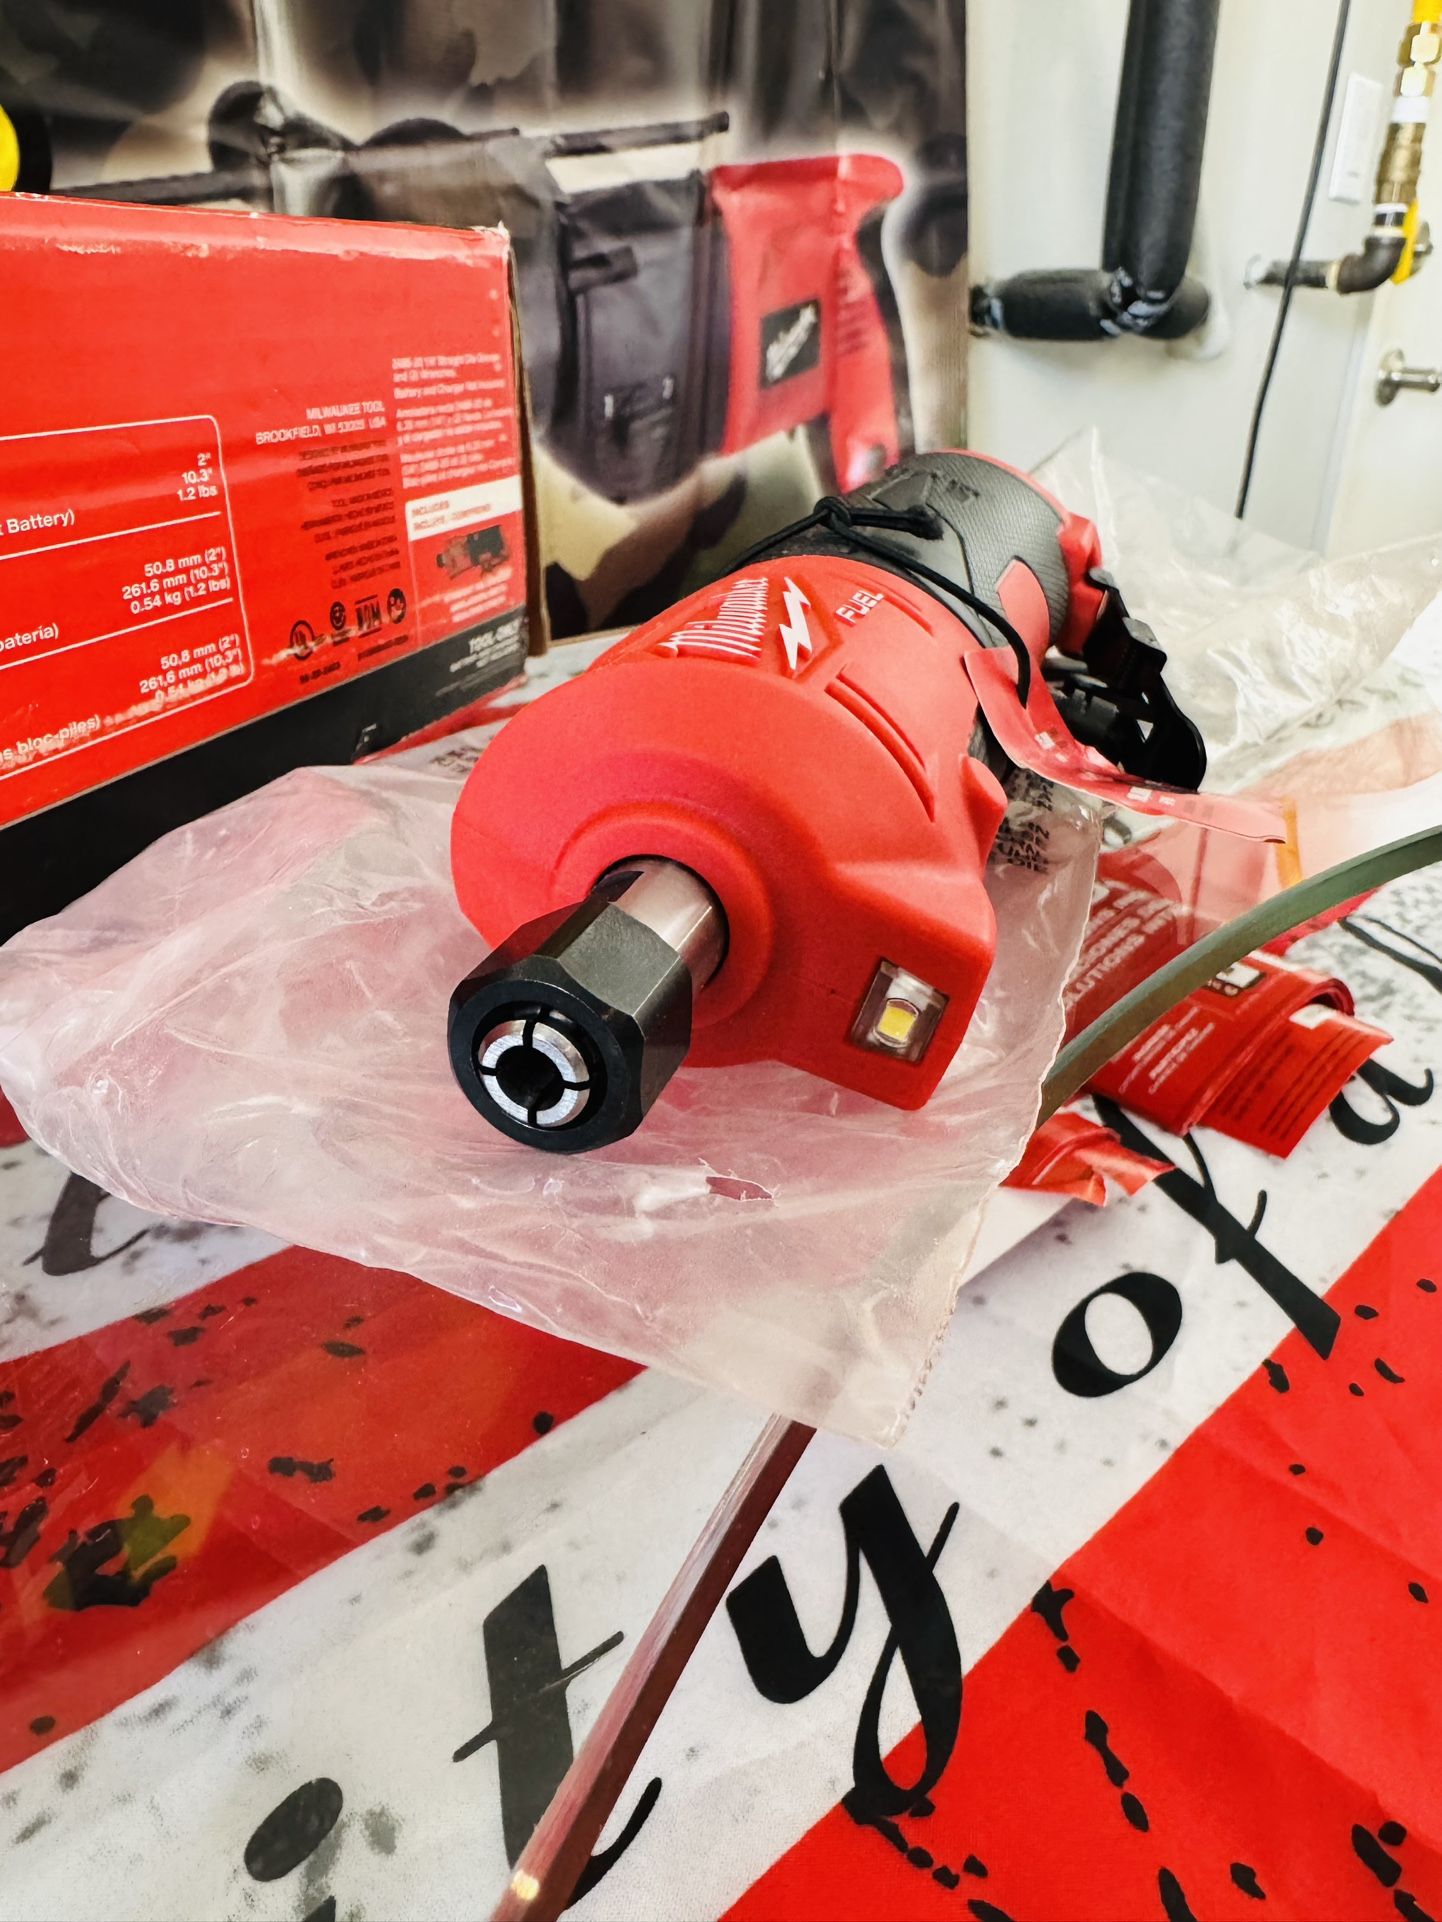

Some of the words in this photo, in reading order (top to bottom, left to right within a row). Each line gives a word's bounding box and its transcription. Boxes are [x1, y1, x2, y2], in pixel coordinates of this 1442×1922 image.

[306, 402, 360, 420] MILWAUKEE
[362, 400, 385, 413] TOOL
[197, 452, 212, 467] 2"
[182, 468, 213, 485] 10.3"
[177, 486, 197, 502] 1.2
[198, 485, 219, 499] lbs
[6, 508, 75, 534] Battery)
[144, 559, 175, 577] 50.8
[178, 554, 202, 568] mm
[205, 546, 227, 564] (2")
[122, 579, 160, 600] 261.6
[163, 573, 188, 589] mm
[190, 562, 228, 584] (10.3")
[130, 594, 162, 614] 0.54
[164, 591, 182, 606] kg
[184, 583, 207, 602] (1.2
[208, 577, 231, 593] lbs)
[835, 589, 885, 624] FUEL
[657, 576, 769, 659] Milwaukee
[193, 643, 217, 659] mm
[218, 633, 240, 652] (2")
[178, 663, 202, 679] mm
[1052, 1092, 1342, 1400] of
